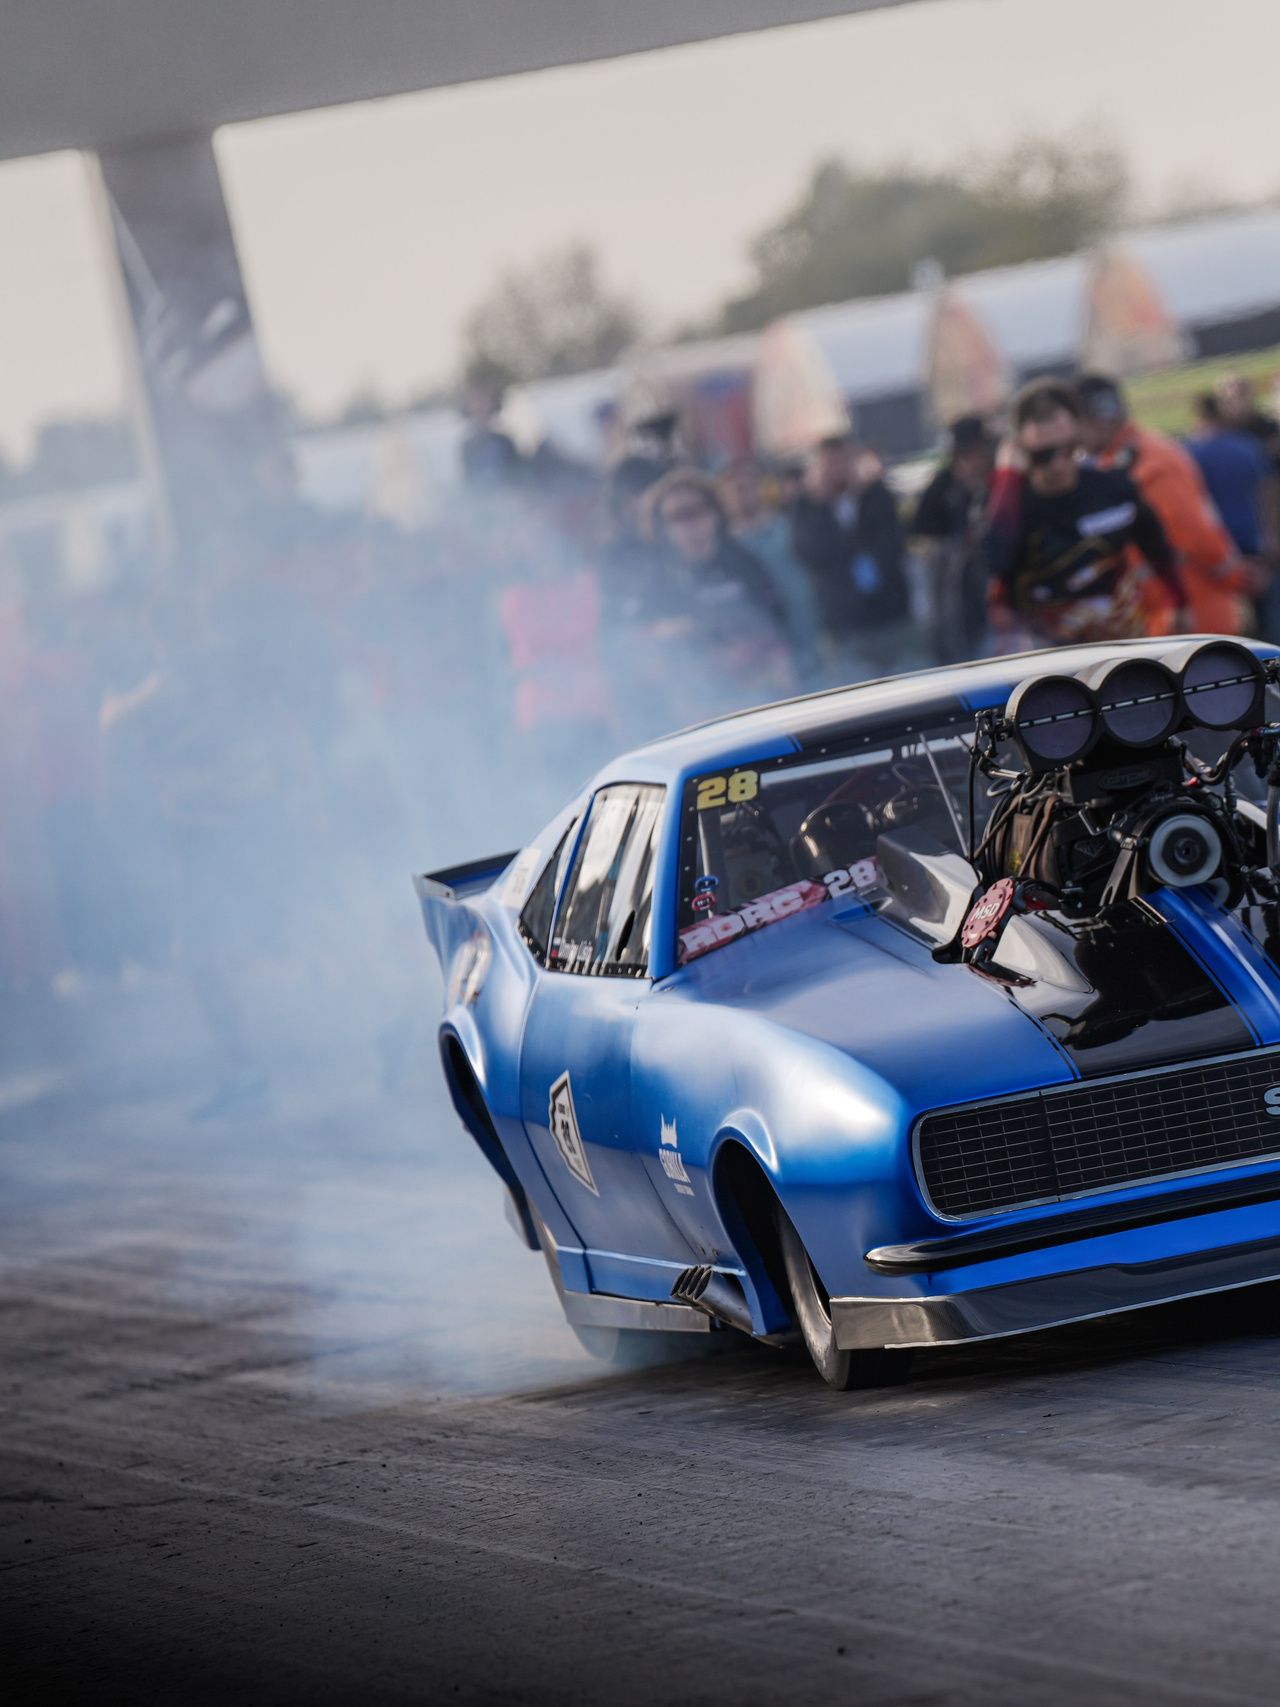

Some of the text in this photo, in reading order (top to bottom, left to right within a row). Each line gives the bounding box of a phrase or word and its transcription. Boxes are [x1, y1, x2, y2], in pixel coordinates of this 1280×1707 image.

[697, 770, 758, 810] 28
[823, 860, 878, 899] 28
[970, 902, 1001, 922] MSD
